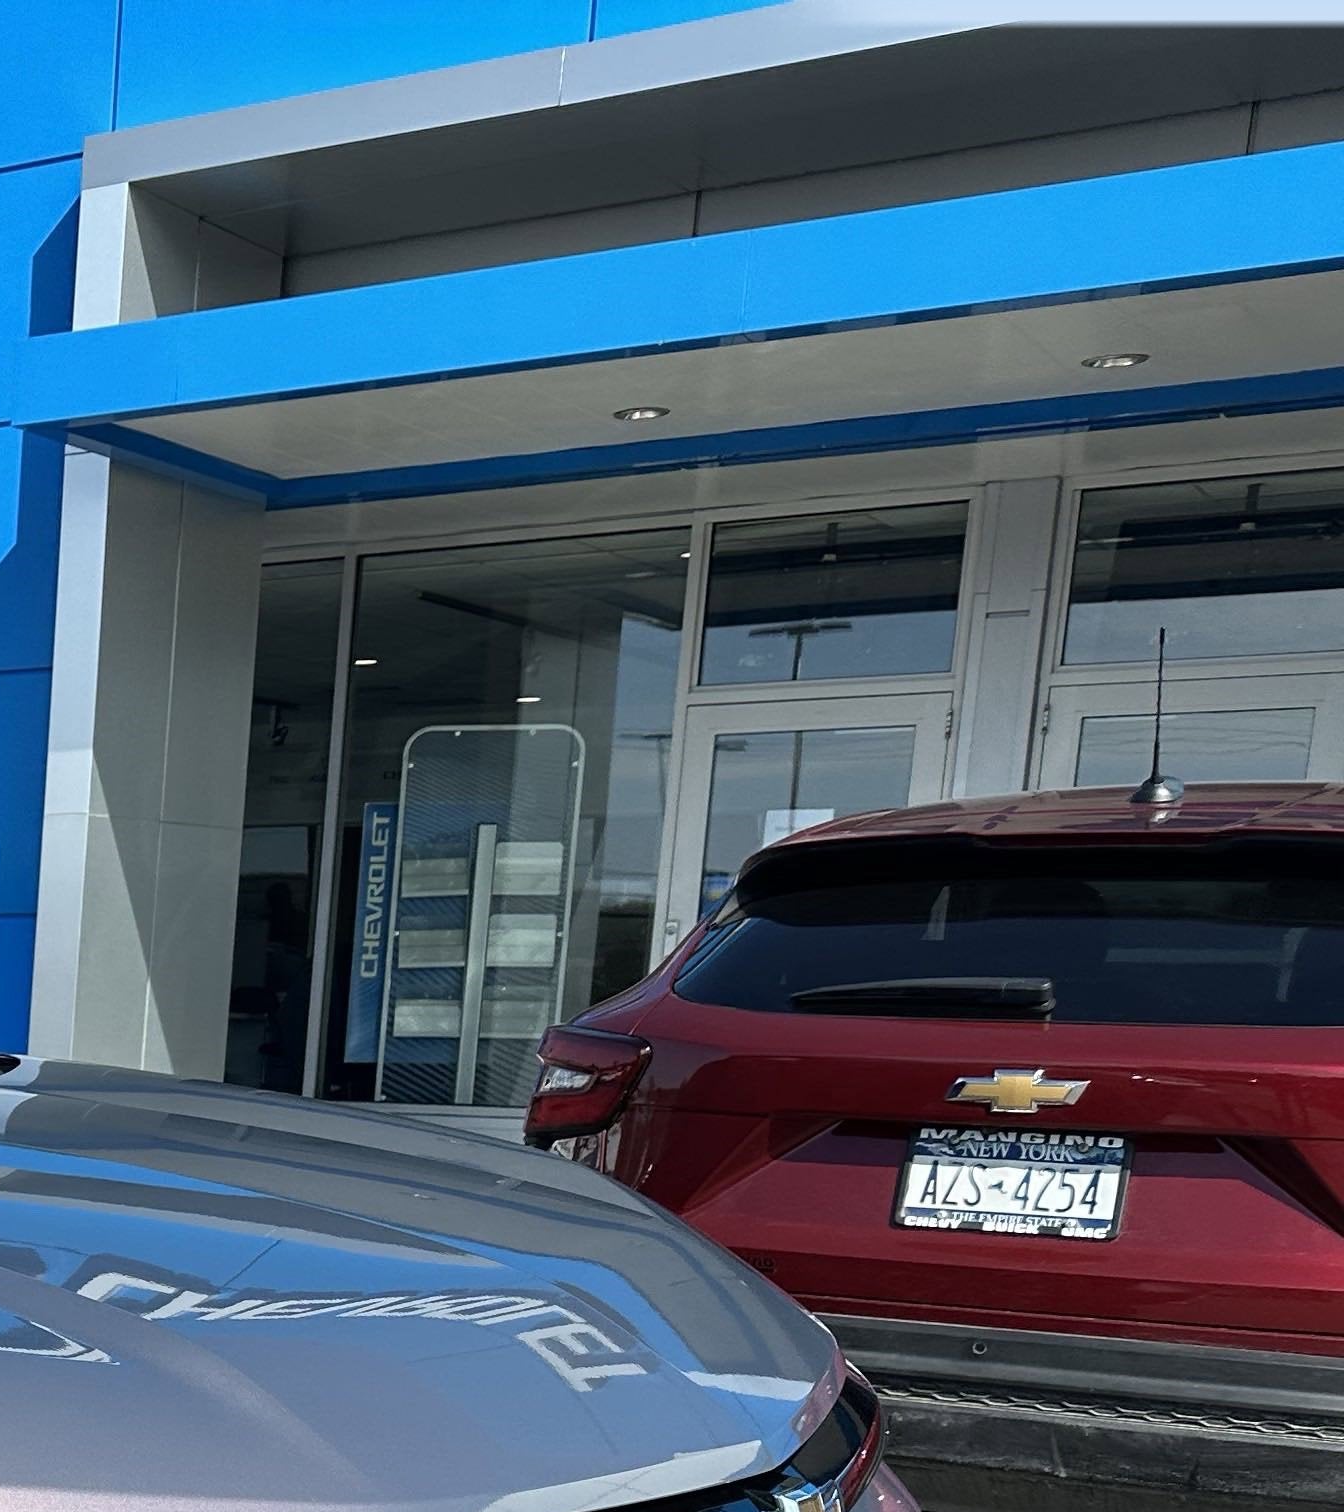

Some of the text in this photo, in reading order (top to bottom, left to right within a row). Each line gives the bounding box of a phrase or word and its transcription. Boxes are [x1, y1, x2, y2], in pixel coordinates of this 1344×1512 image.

[359, 811, 391, 979] CHEVROLET
[919, 1127, 1125, 1148] MANGINO
[963, 1141, 1075, 1163] NEW YORK
[904, 1215, 963, 1230] CHEVY
[951, 1211, 977, 1223] THE
